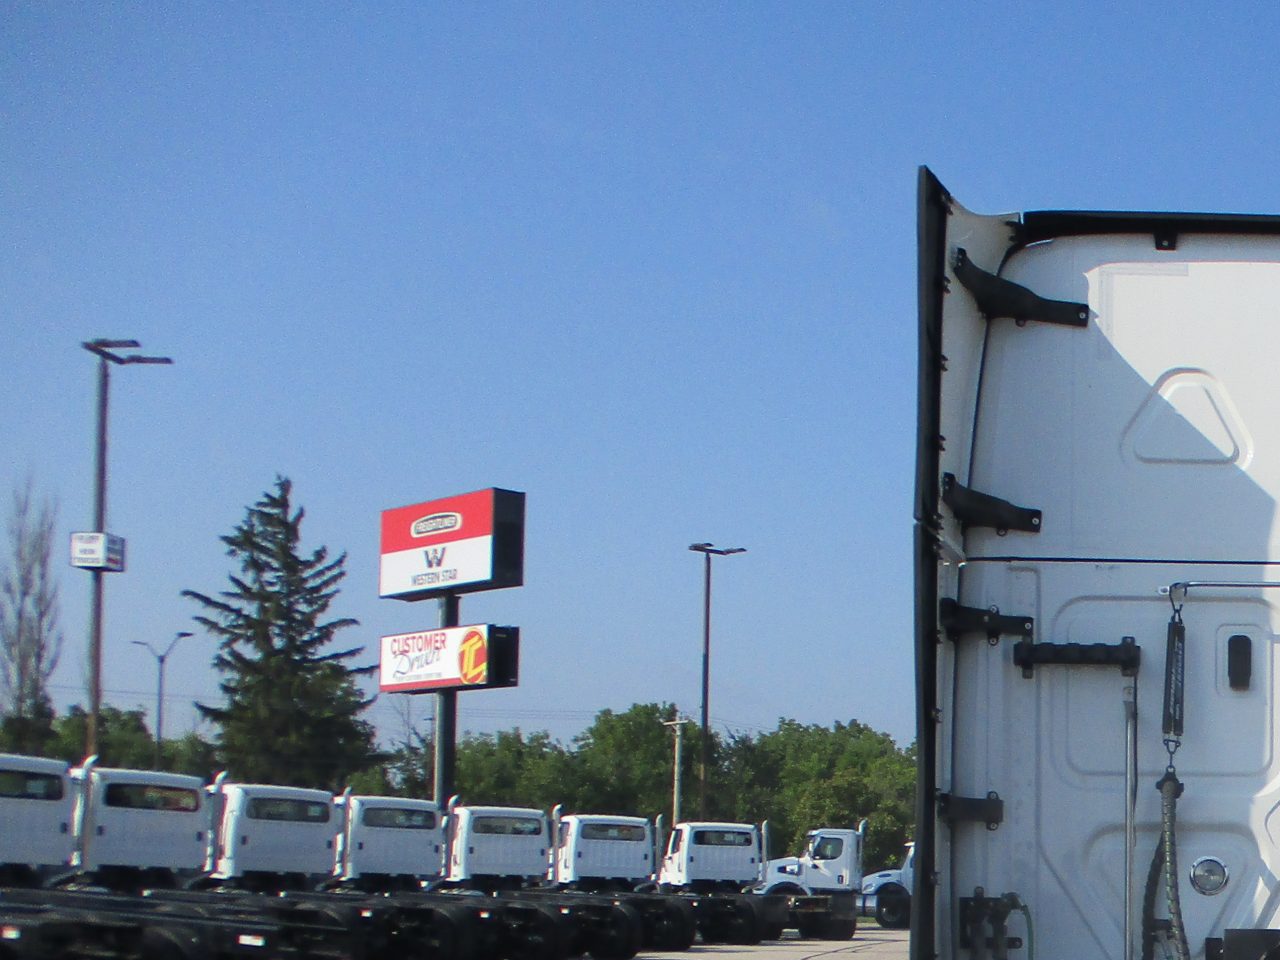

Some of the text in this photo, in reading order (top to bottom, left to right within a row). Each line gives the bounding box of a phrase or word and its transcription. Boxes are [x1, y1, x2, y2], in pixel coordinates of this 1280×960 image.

[411, 568, 457, 586] WESTERN STAR
[390, 632, 447, 654] CUSTOMER
